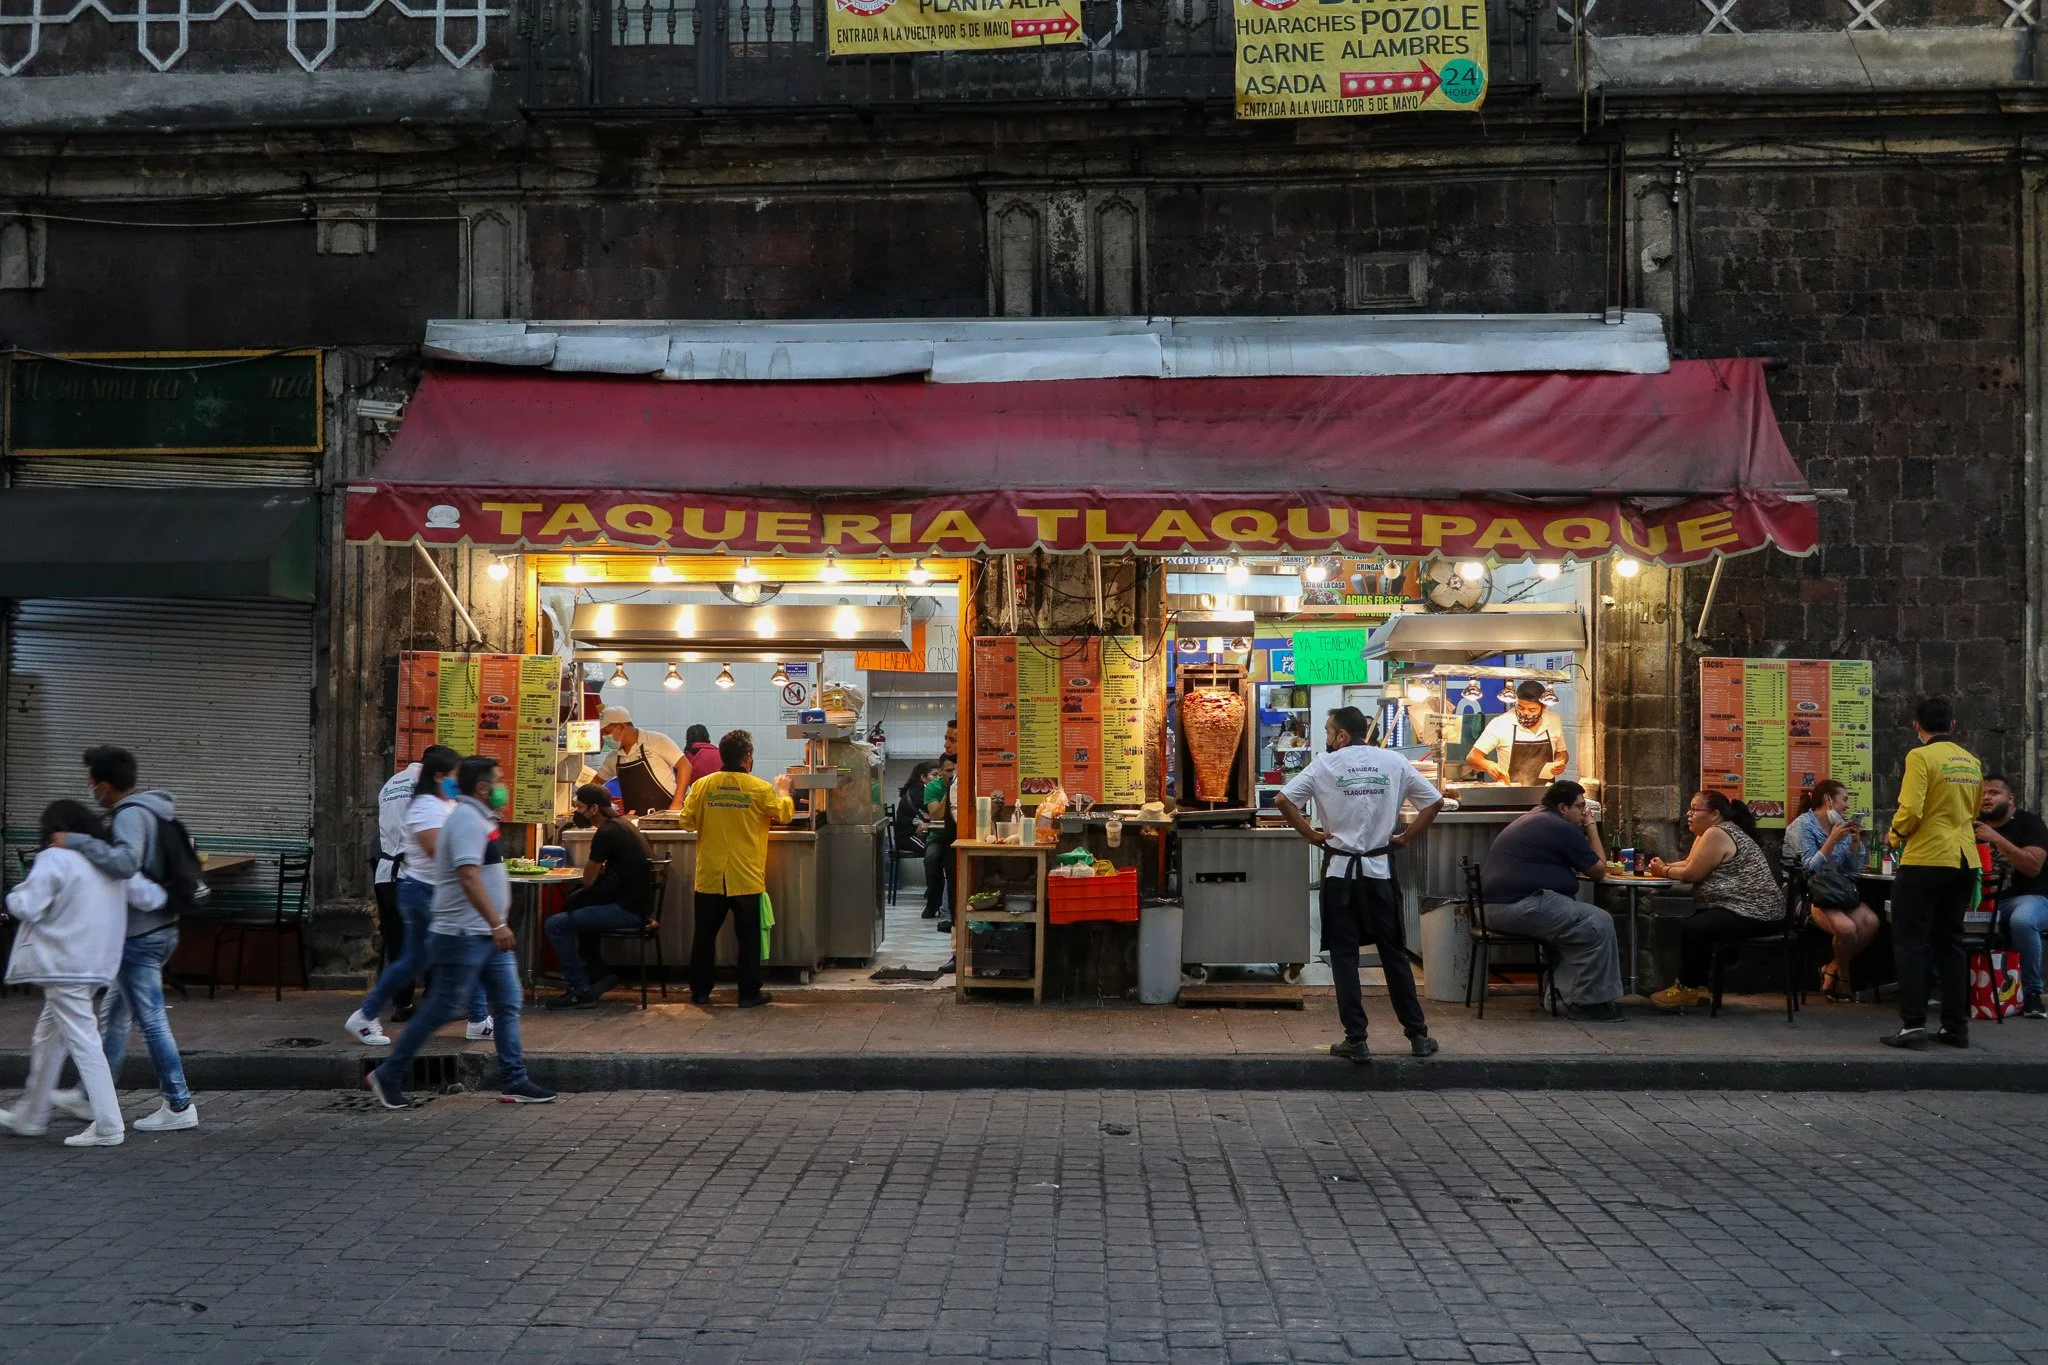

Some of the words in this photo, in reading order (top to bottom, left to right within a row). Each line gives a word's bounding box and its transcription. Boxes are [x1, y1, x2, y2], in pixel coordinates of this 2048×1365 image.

[1237, 15, 1356, 35] HUARACHES
[1362, 5, 1480, 34] POZOLE
[837, 28, 879, 43] ENTRADA
[883, 28, 889, 41] A
[891, 27, 902, 41] LA
[904, 26, 936, 41] VUELTA
[939, 24, 956, 39] POR
[960, 23, 966, 37] 5
[969, 23, 980, 37] DE
[984, 21, 1009, 36] MAYO
[1243, 42, 1325, 64] CARNE
[1341, 35, 1470, 59] ALAMBRES
[1244, 74, 1326, 95] ASADA
[1445, 67, 1477, 86] 24
[1444, 88, 1481, 97] HORAS
[1244, 101, 1286, 117] ENTRADA
[1290, 101, 1296, 115] A
[1297, 101, 1310, 115] LA
[1312, 99, 1344, 114] VUELTA
[1346, 97, 1365, 113] POR
[1368, 97, 1374, 111] 5
[1377, 96, 1389, 111] DE
[1393, 95, 1418, 110] MAYO
[481, 501, 986, 545] TAQUERIA
[1016, 506, 1740, 558] TLAQUEPAQUE
[1346, 595, 1374, 604] AGUAS
[1298, 637, 1311, 651] YA
[1316, 634, 1365, 651] TENEMOS
[855, 650, 870, 669] YA
[874, 650, 926, 671] TENEMOS
[1296, 658, 1367, 681] CARNITAS
